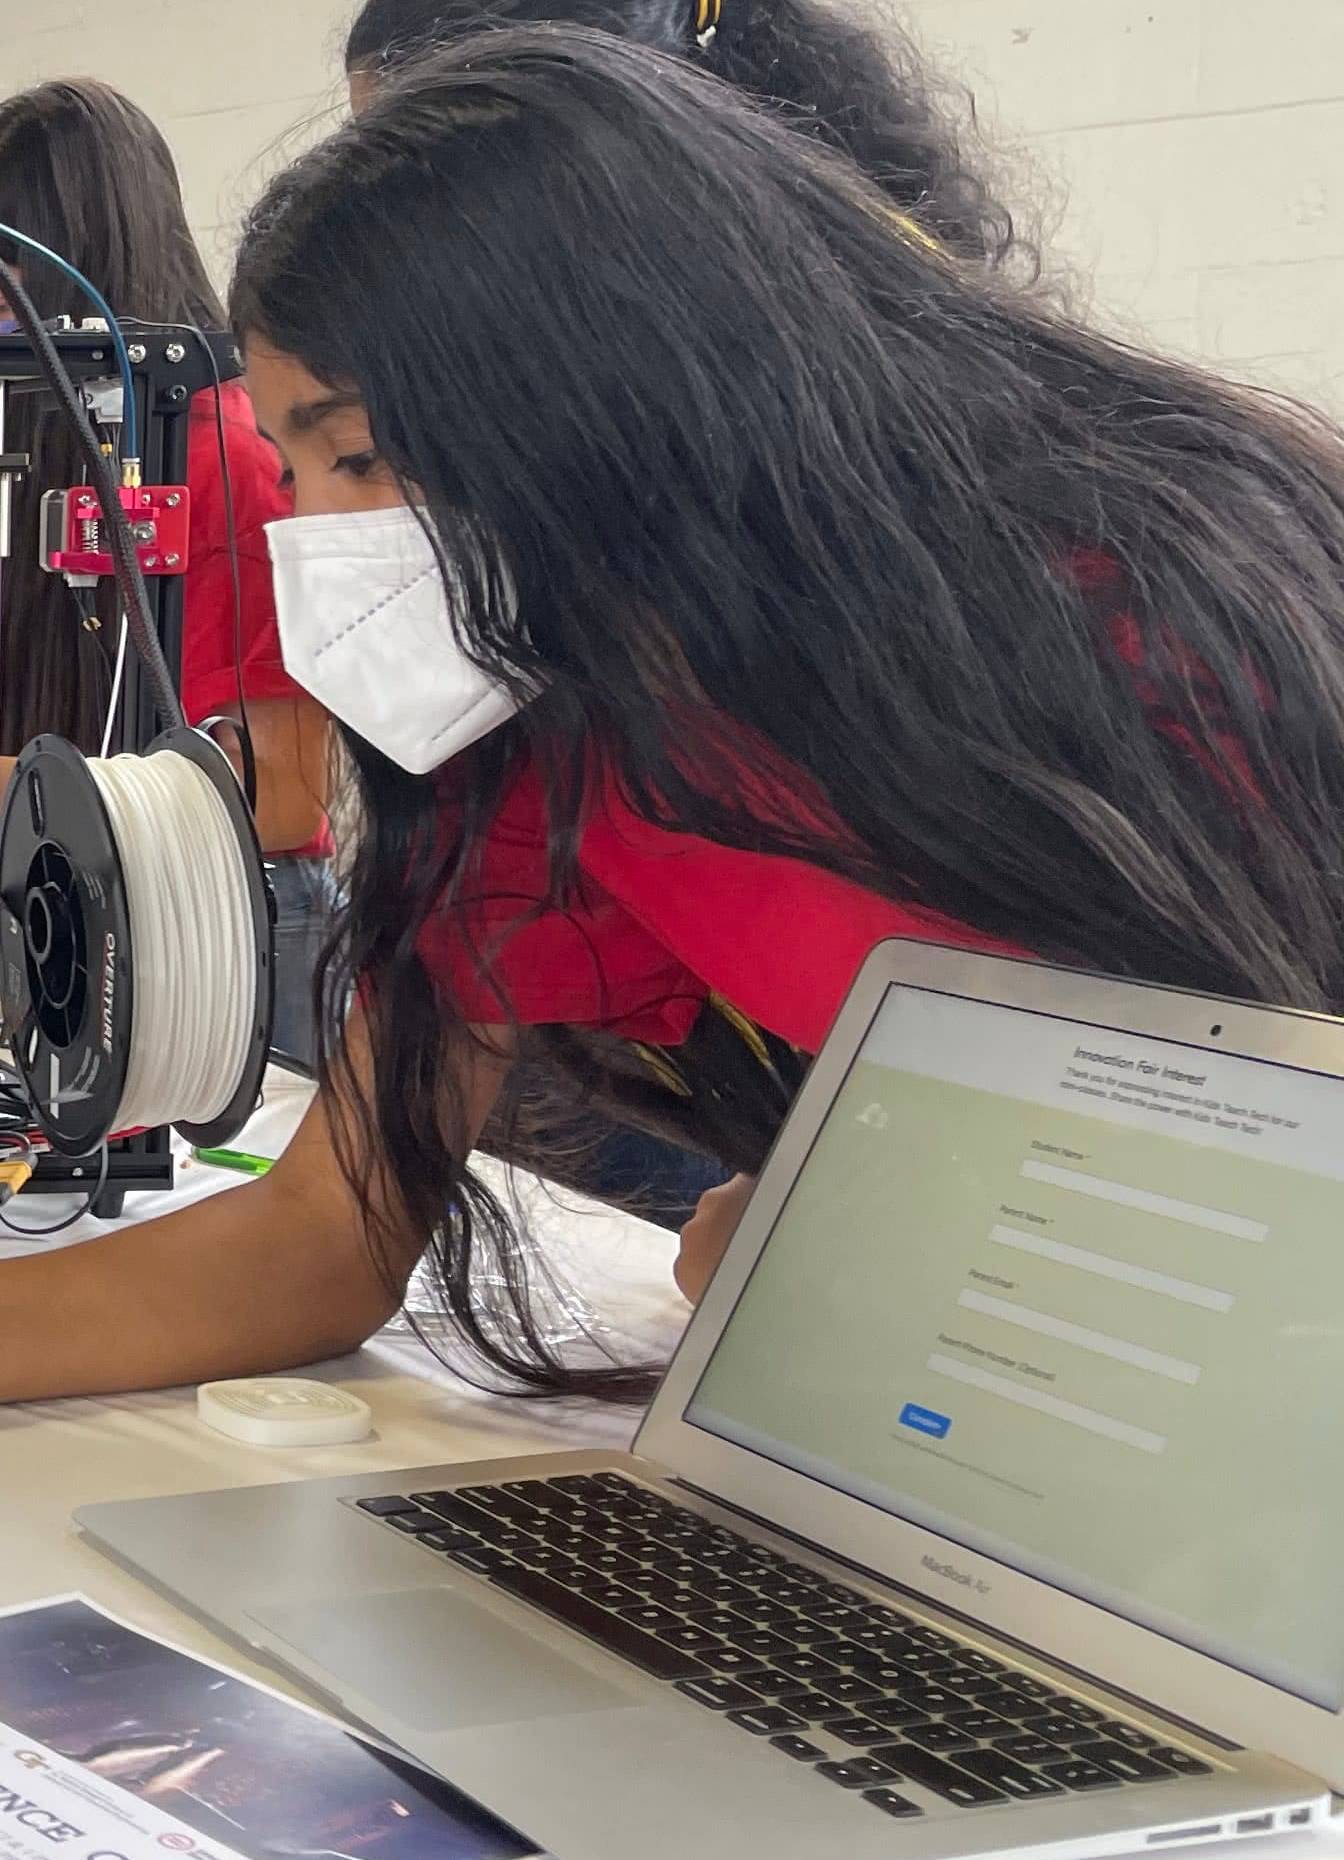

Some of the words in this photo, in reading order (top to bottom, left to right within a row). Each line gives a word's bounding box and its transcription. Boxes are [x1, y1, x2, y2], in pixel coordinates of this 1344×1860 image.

[103, 932, 116, 1053] OVERTURE
[1073, 1046, 1134, 1069] Innovation
[1136, 1060, 1159, 1075] Fair
[1162, 1066, 1208, 1086] Interest
[921, 1554, 973, 1587] MacBook
